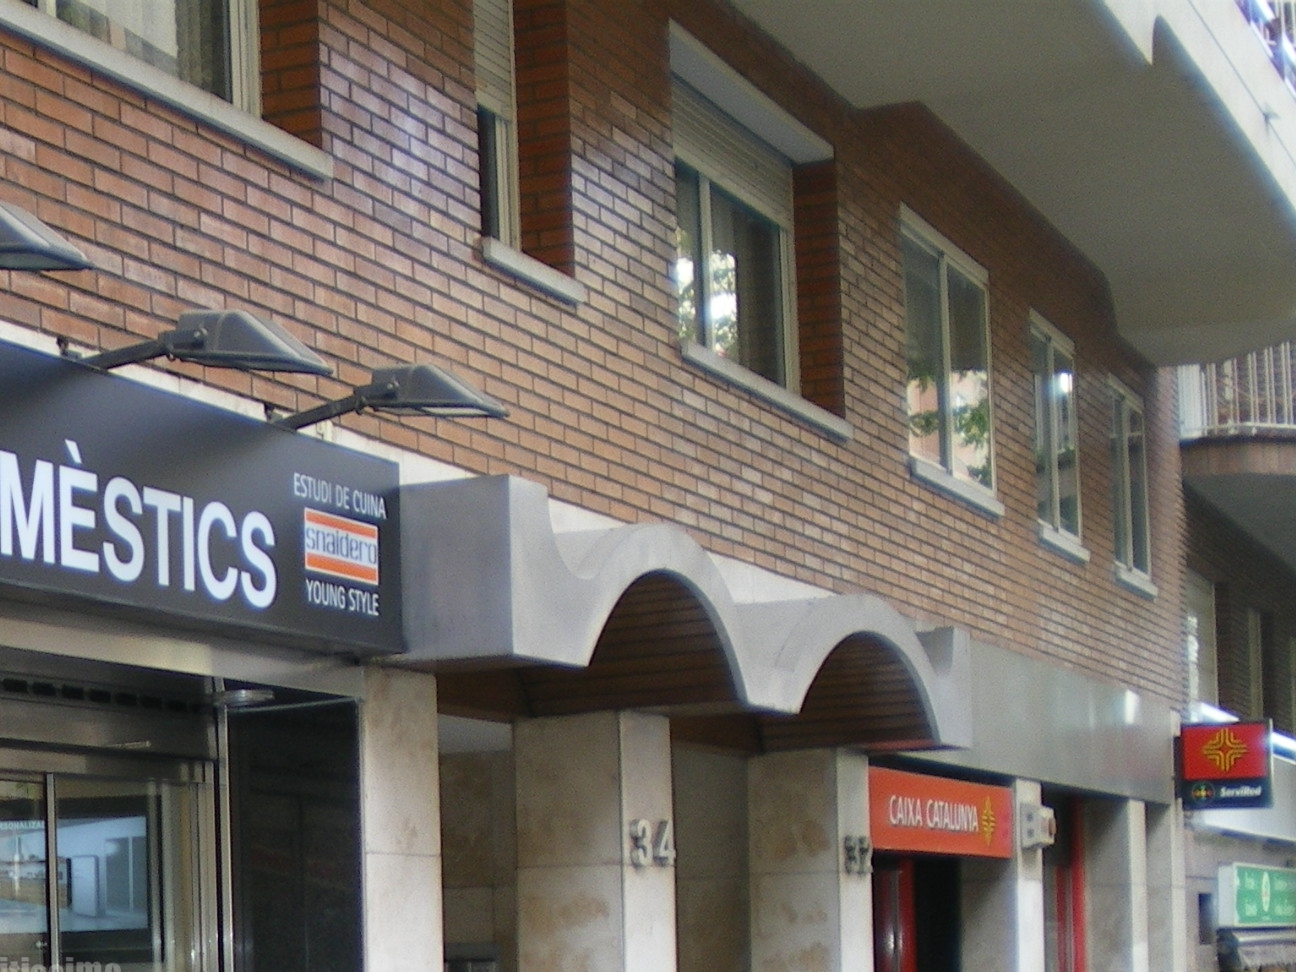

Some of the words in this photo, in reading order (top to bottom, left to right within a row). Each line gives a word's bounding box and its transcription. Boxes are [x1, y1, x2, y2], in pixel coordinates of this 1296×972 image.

[293, 472, 332, 504] ESTUDI
[335, 485, 350, 510] DE
[353, 490, 387, 520] CUINA
[306, 527, 377, 565] snaidero
[306, 579, 346, 609] YOUNG
[348, 587, 380, 616] STYLE
[889, 795, 922, 827] CAIXA
[926, 799, 979, 832] CATALUNYA
[629, 818, 676, 868] 34
